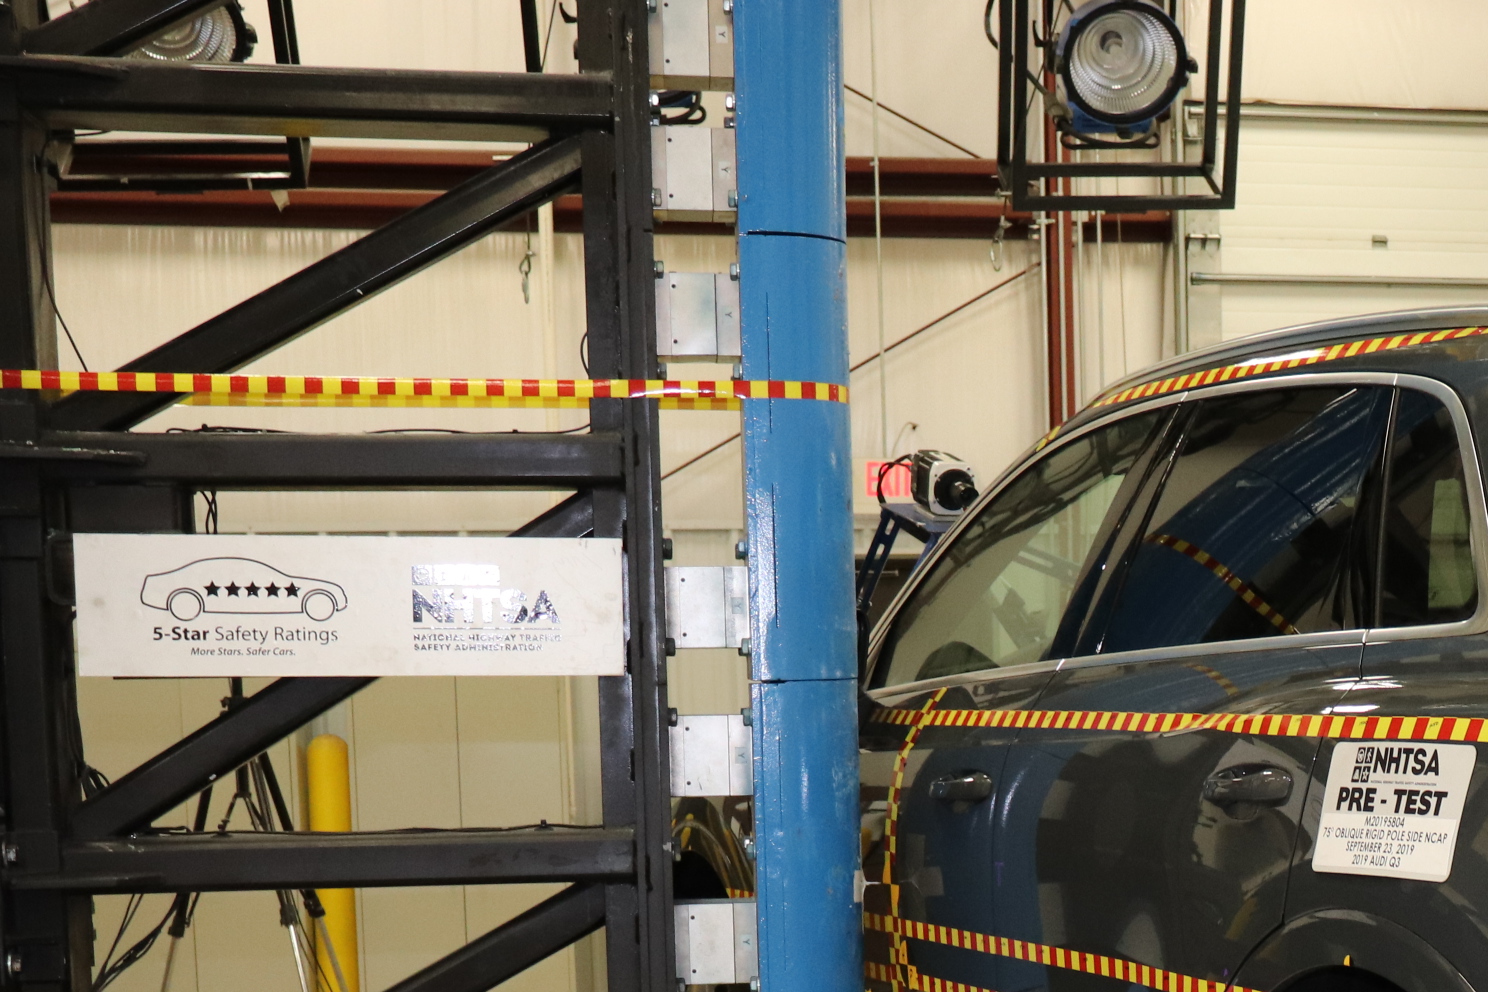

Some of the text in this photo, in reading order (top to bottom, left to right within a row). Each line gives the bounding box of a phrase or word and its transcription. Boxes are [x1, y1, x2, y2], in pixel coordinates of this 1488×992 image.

[412, 588, 560, 624] NHTSA
[153, 626, 338, 645] 5-Star Safety Ratings
[190, 647, 296, 656] More Stars. Safer Cars.
[414, 643, 451, 651] SAFETY
[1372, 747, 1439, 776] NHTSA
[1336, 786, 1377, 812] PRE
[1394, 789, 1448, 816] TEST
[1364, 816, 1405, 828] M20195804
[1335, 827, 1364, 839] OBLIQUE
[1365, 828, 1385, 840] RIGID
[1386, 829, 1406, 841] POLE
[1406, 831, 1423, 842] SIDE
[1424, 832, 1448, 844] NCAP
[1346, 841, 1415, 855] SEPTEMBER 23, 2019
[1352, 854, 1401, 868] 2019 AUDI Q3
